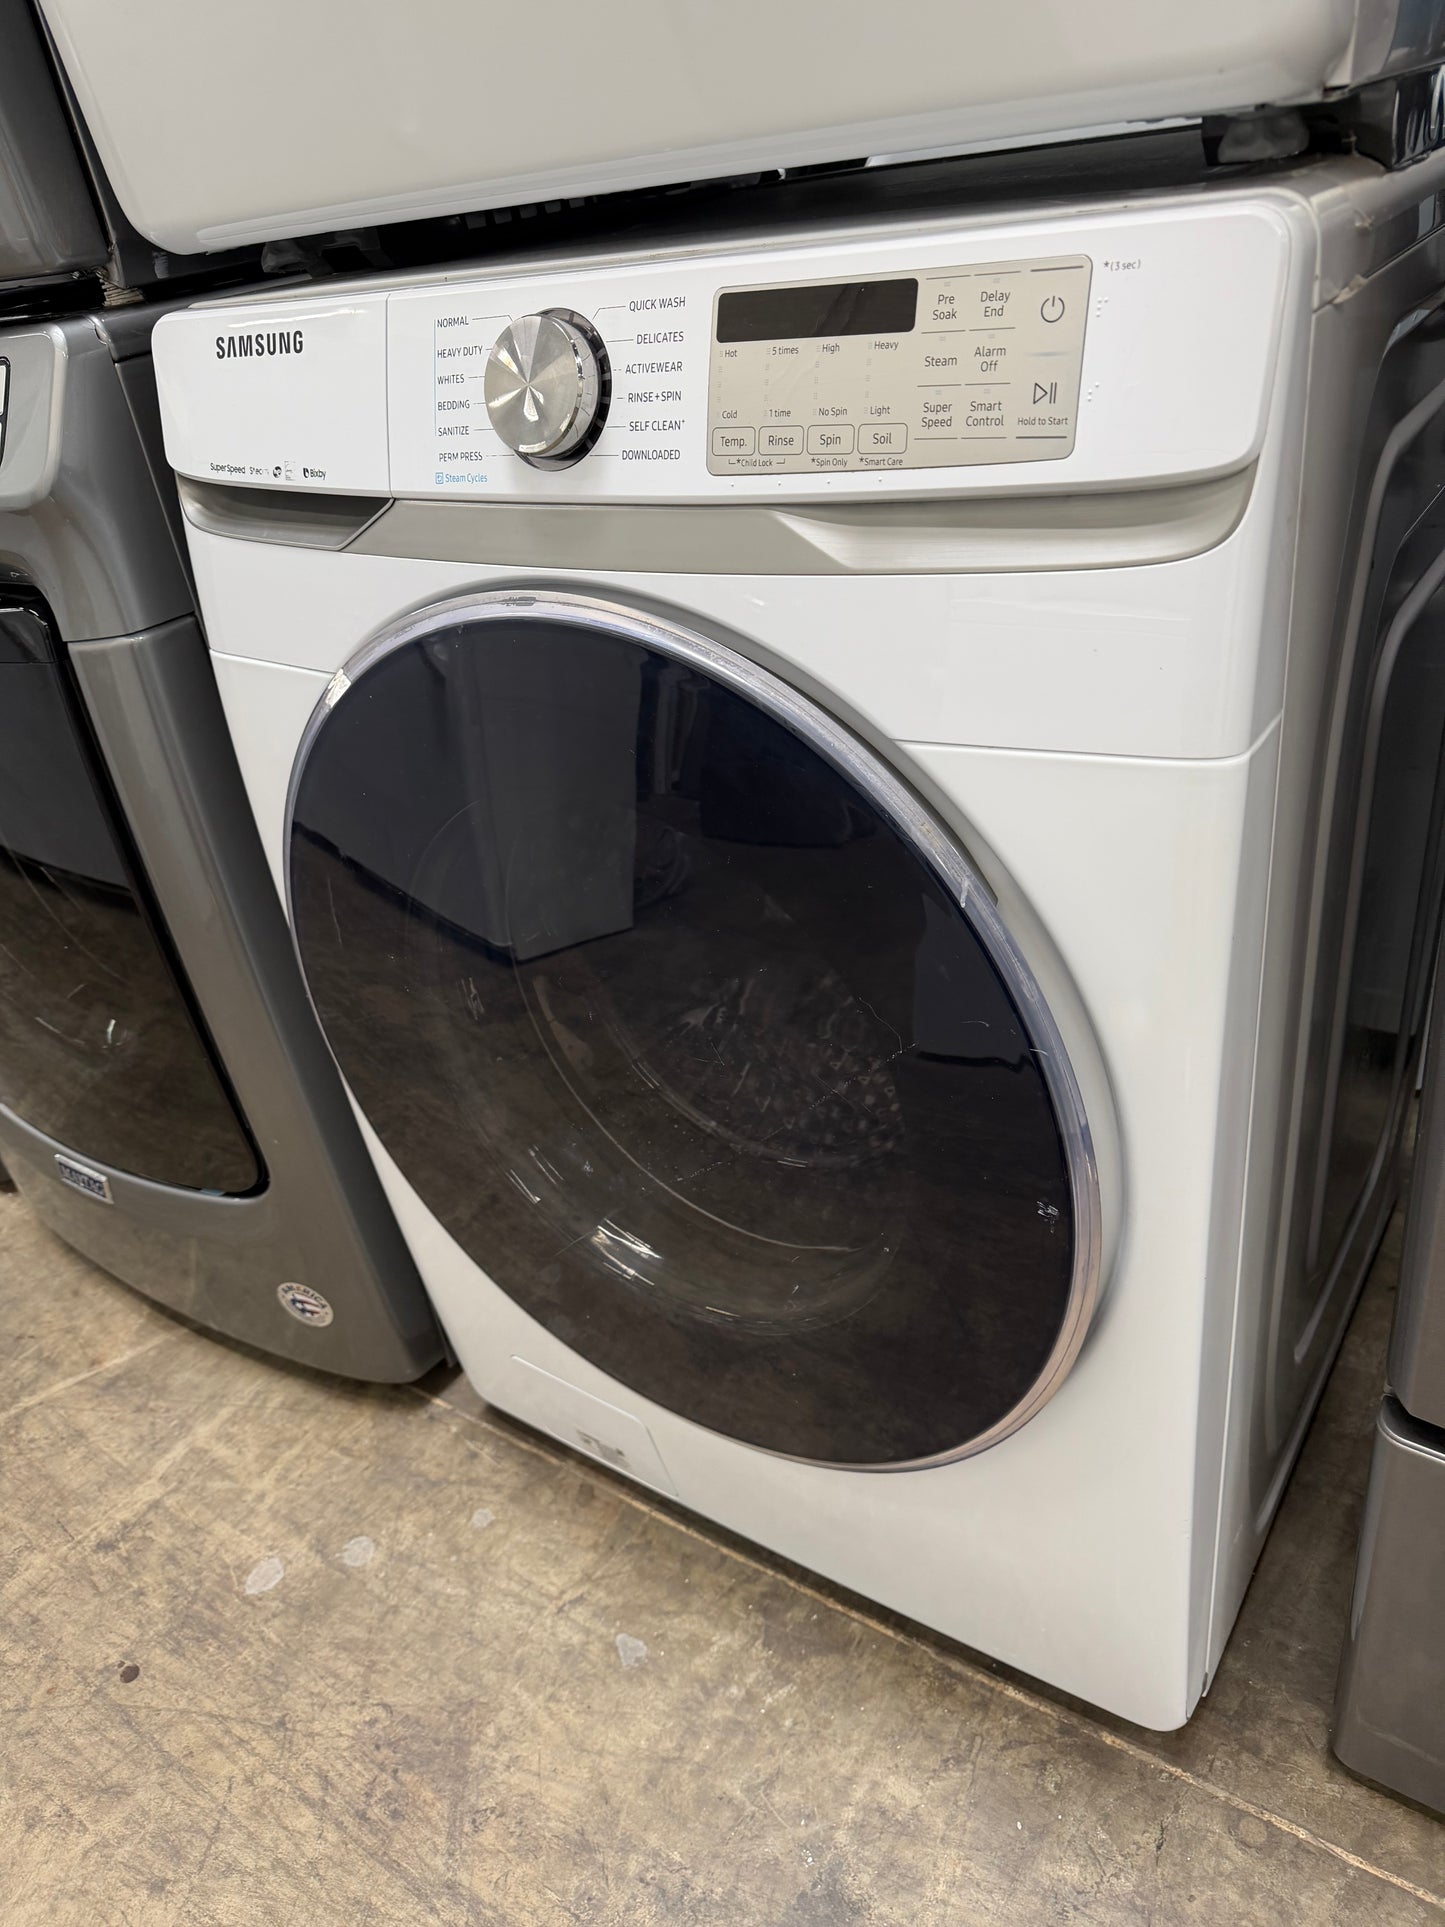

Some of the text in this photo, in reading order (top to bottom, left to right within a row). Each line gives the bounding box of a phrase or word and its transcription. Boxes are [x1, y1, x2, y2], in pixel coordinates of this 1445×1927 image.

[1122, 259, 1141, 271] sec)
[938, 294, 955, 304] Pre
[981, 291, 1010, 303] Delay
[629, 297, 685, 311] QUICK WASH
[933, 310, 957, 320] Soak
[984, 306, 1004, 317] End
[437, 316, 469, 328] NORMAL
[636, 332, 684, 344] DELICATES
[216, 330, 304, 359] SAMSUNG
[822, 344, 840, 354] High
[874, 341, 898, 351] Heavy
[437, 346, 483, 358] HEAVY DUTY
[725, 350, 737, 358] Hot
[772, 347, 798, 355] 5 times
[974, 346, 1006, 357] Alarm
[925, 356, 958, 367] Steam
[981, 361, 998, 372] Off
[626, 362, 682, 374] ACTIVEWEAR
[438, 374, 464, 384] WHITES
[438, 400, 470, 411] BEDDING
[870, 407, 890, 415] Light
[923, 403, 952, 414] Super
[970, 402, 1002, 412] Smart
[722, 411, 737, 419] Cold
[819, 408, 847, 417] No Spin
[629, 421, 649, 431] SELF
[922, 417, 952, 429] Speed
[966, 416, 1004, 426] Control
[1018, 417, 1068, 425] Hold to Start
[438, 426, 469, 437] SANITIZE
[720, 436, 747, 448] Temp.
[768, 435, 794, 446] Rinse
[820, 434, 841, 448] Spin
[872, 433, 891, 444] Soil
[439, 452, 483, 462] PERM PRESS
[622, 450, 680, 460] DOWNLOADED
[832, 458, 847, 467] Only
[888, 458, 903, 466] Care
[310, 469, 326, 480] Bixby
[445, 473, 488, 483] Steam Cycles
